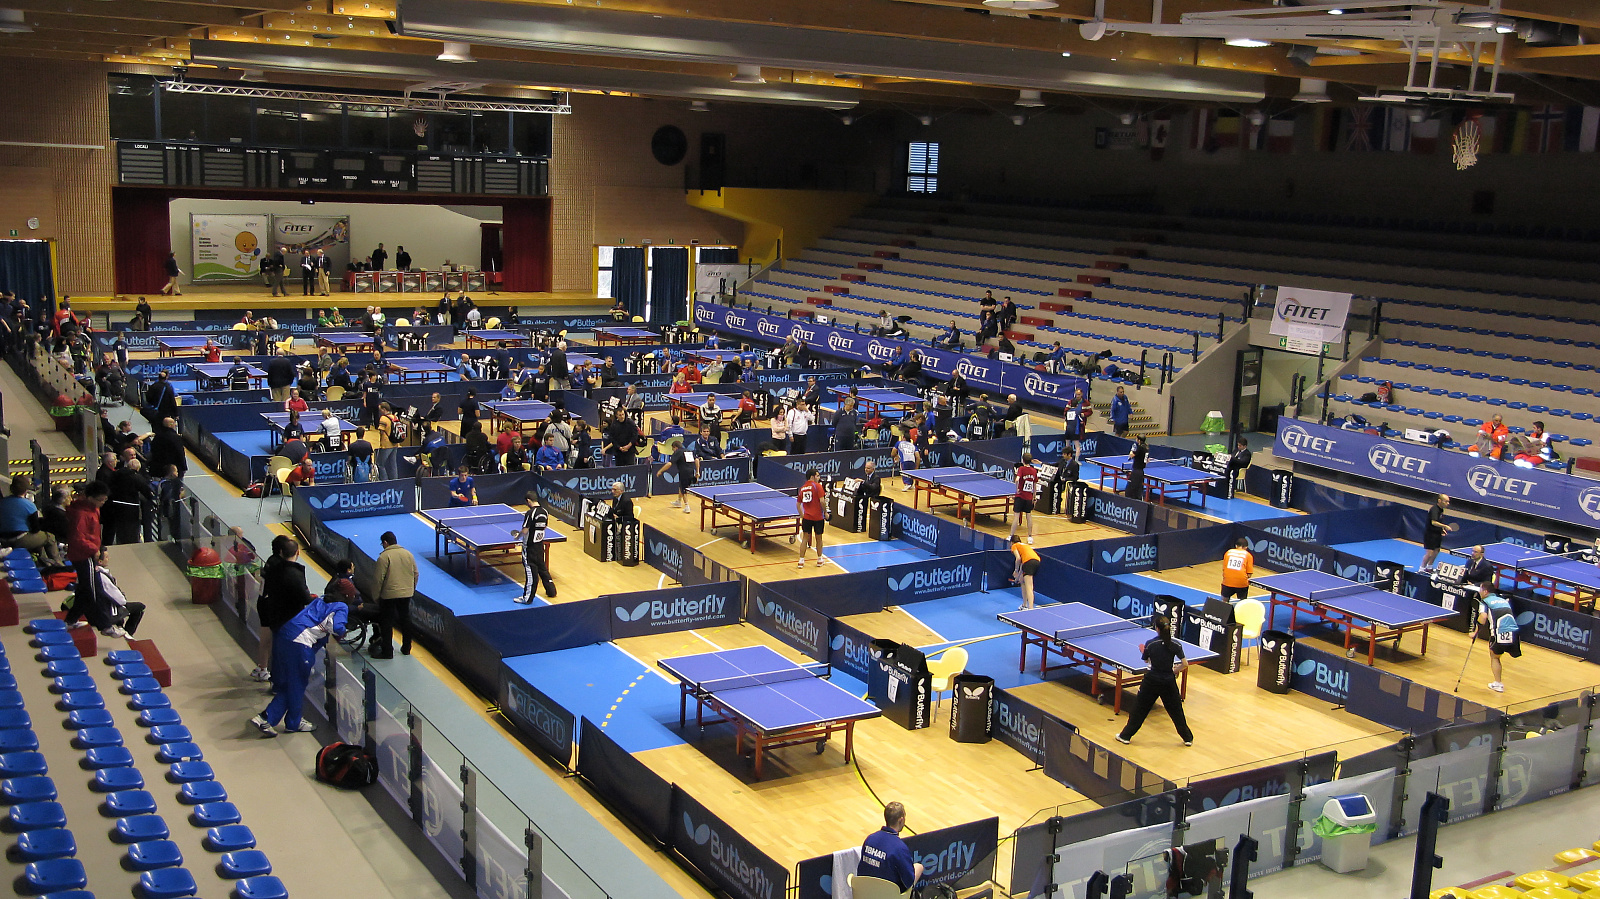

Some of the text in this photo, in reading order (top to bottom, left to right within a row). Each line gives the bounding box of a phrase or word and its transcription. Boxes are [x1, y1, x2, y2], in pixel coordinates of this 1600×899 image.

[284, 224, 314, 232] FITET
[699, 309, 715, 320] FITET
[726, 315, 747, 326] FITET
[1283, 304, 1331, 320] FITET
[758, 322, 780, 334] FITET
[792, 328, 816, 341] FITET
[829, 335, 854, 349] FITET
[869, 344, 895, 358] FITET
[141, 362, 188, 375] Butterfly
[958, 364, 990, 379] FITET
[1027, 377, 1060, 394] FITET
[1284, 431, 1337, 453] FITET
[792, 458, 841, 473] Butterfly
[1372, 450, 1431, 474] FITET
[1470, 471, 1538, 496] FITET
[339, 488, 404, 508] Butterfly
[1094, 498, 1140, 524] Butterfly
[902, 514, 940, 542] Butterfly
[1272, 522, 1318, 540] Butterfly
[606, 535, 614, 562] Butterfly
[1267, 540, 1324, 571] Butterfly
[1228, 556, 1243, 568] 138
[1442, 565, 1449, 574] 9
[914, 563, 973, 589] Butterfly
[1452, 568, 1458, 577] 8
[914, 581, 972, 596] www.butterfly-world.com
[1441, 583, 1467, 598] Butterfly
[651, 594, 726, 620] Butterfly
[650, 612, 726, 628] www.butterfly-world.com
[774, 603, 820, 647] Butterfly
[1200, 618, 1225, 635] Butterfly
[1201, 634, 1210, 644] 18
[1500, 631, 1510, 641] 82
[1229, 642, 1238, 674] Butterfly
[888, 665, 909, 685] Butterfly
[1277, 655, 1288, 685] Butterfly
[915, 693, 926, 729] Butterfly
[951, 696, 960, 731] Butterfly
[985, 699, 994, 733] Butterfly
[710, 826, 774, 899] Butterfly
